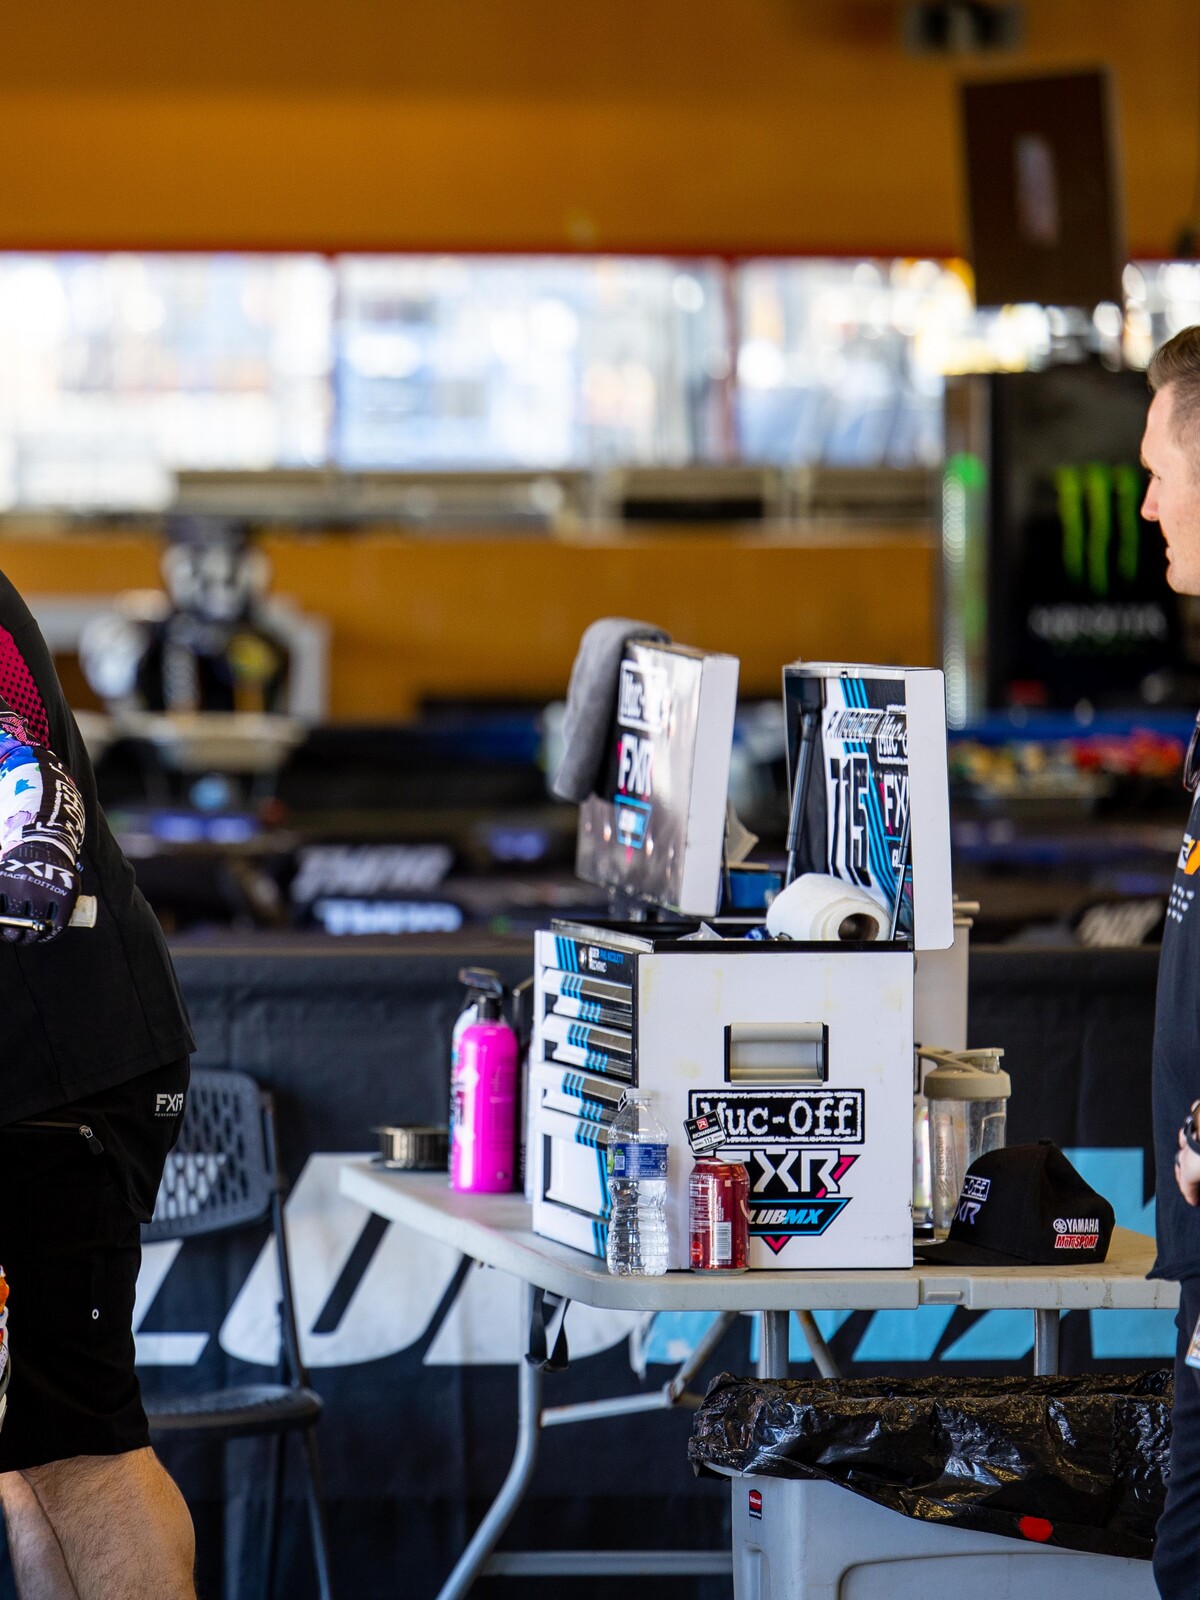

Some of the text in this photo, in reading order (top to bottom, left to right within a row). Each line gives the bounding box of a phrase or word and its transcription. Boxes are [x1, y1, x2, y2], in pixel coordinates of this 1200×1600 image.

[3, 872, 27, 883] RACE
[27, 877, 68, 897] EDITION
[155, 1092, 184, 1112] FXR
[749, 1208, 824, 1225] LUBMX
[1065, 1217, 1100, 1234] YAMAHA
